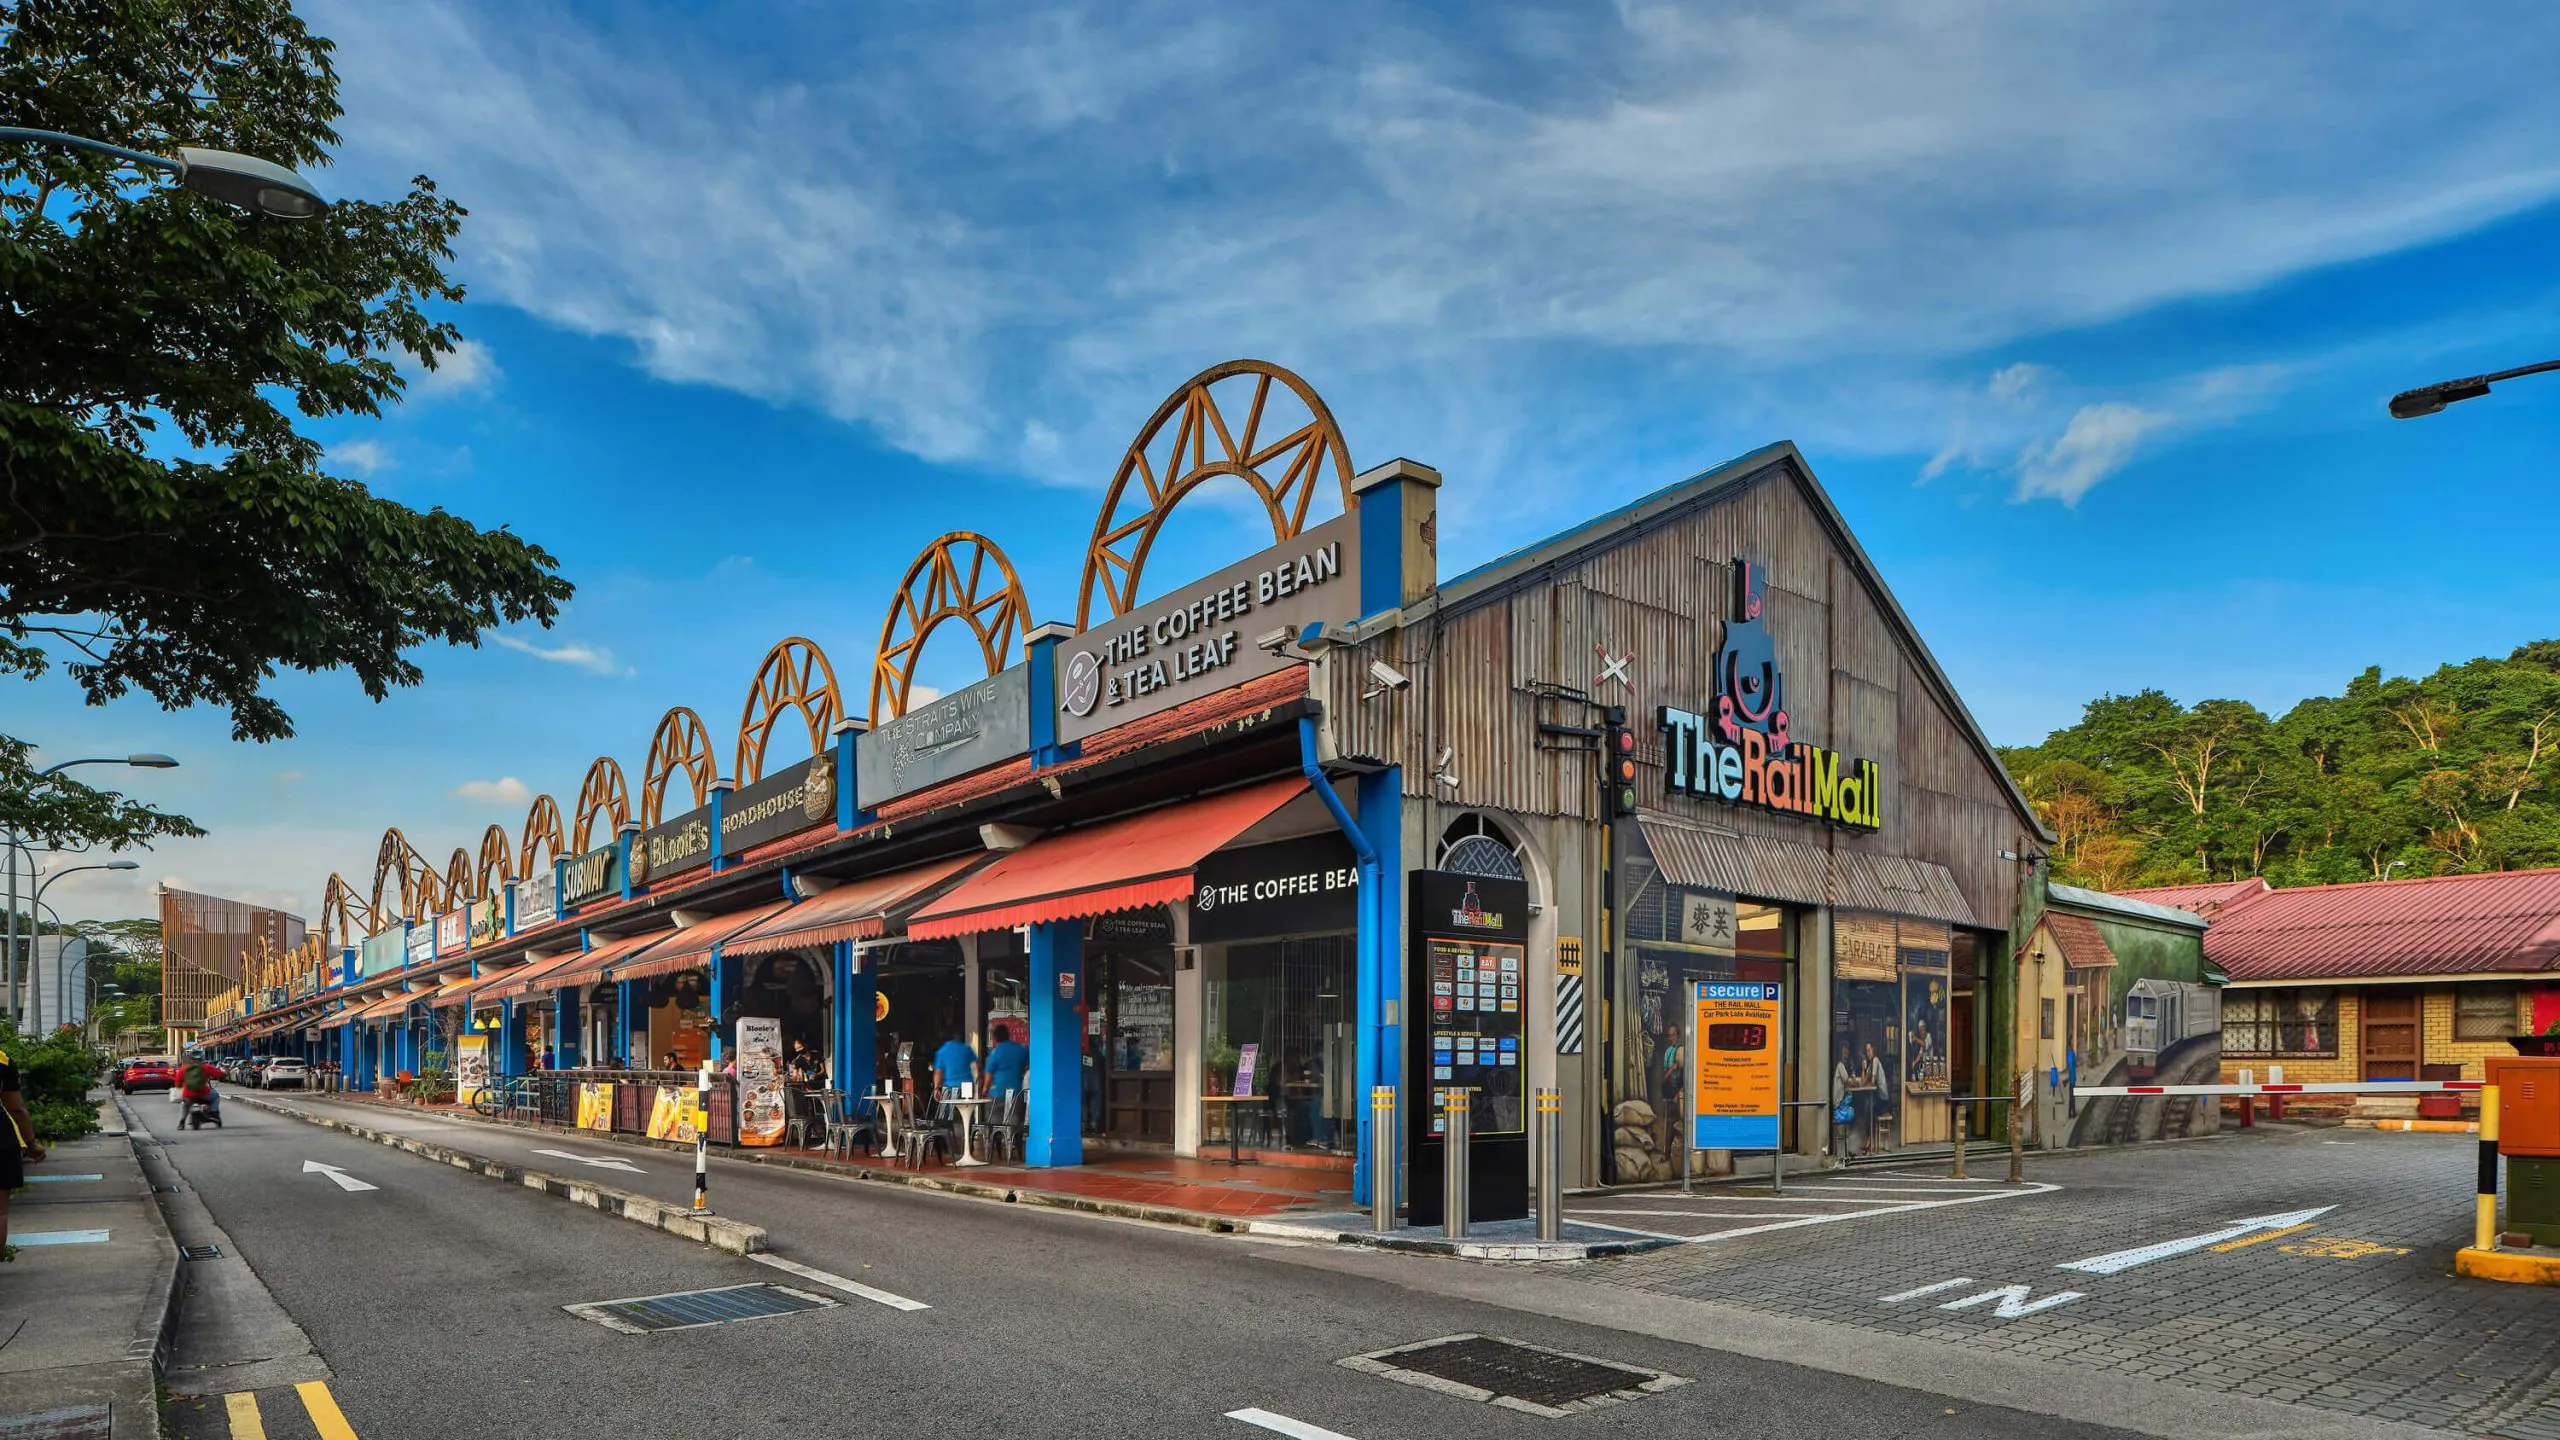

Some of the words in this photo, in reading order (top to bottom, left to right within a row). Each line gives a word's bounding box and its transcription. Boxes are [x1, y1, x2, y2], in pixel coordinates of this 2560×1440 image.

[1105, 624, 1148, 666] THE
[1153, 580, 1251, 645] COFFEE
[1257, 541, 1341, 605] BEAN
[1123, 660, 1169, 698] TEA
[1175, 631, 1238, 681] LEAF
[880, 724, 902, 746] THE
[905, 701, 957, 735] STRAITS
[960, 684, 996, 710] WINE
[915, 711, 981, 748] COMPANY
[721, 786, 804, 834] ROADHOUSE
[564, 850, 611, 902] SUBWAY
[1219, 884, 1248, 904] THE
[1254, 873, 1318, 900] COFFEE
[1325, 867, 1359, 889] BEA
[1842, 935, 1890, 963] SARABAT
[1709, 985, 1760, 997] secure
[1766, 987, 1776, 998] P
[1745, 1011, 1771, 1019] Available
[1743, 1026, 1762, 1046] 13
[1877, 1277, 2087, 1319] IN
